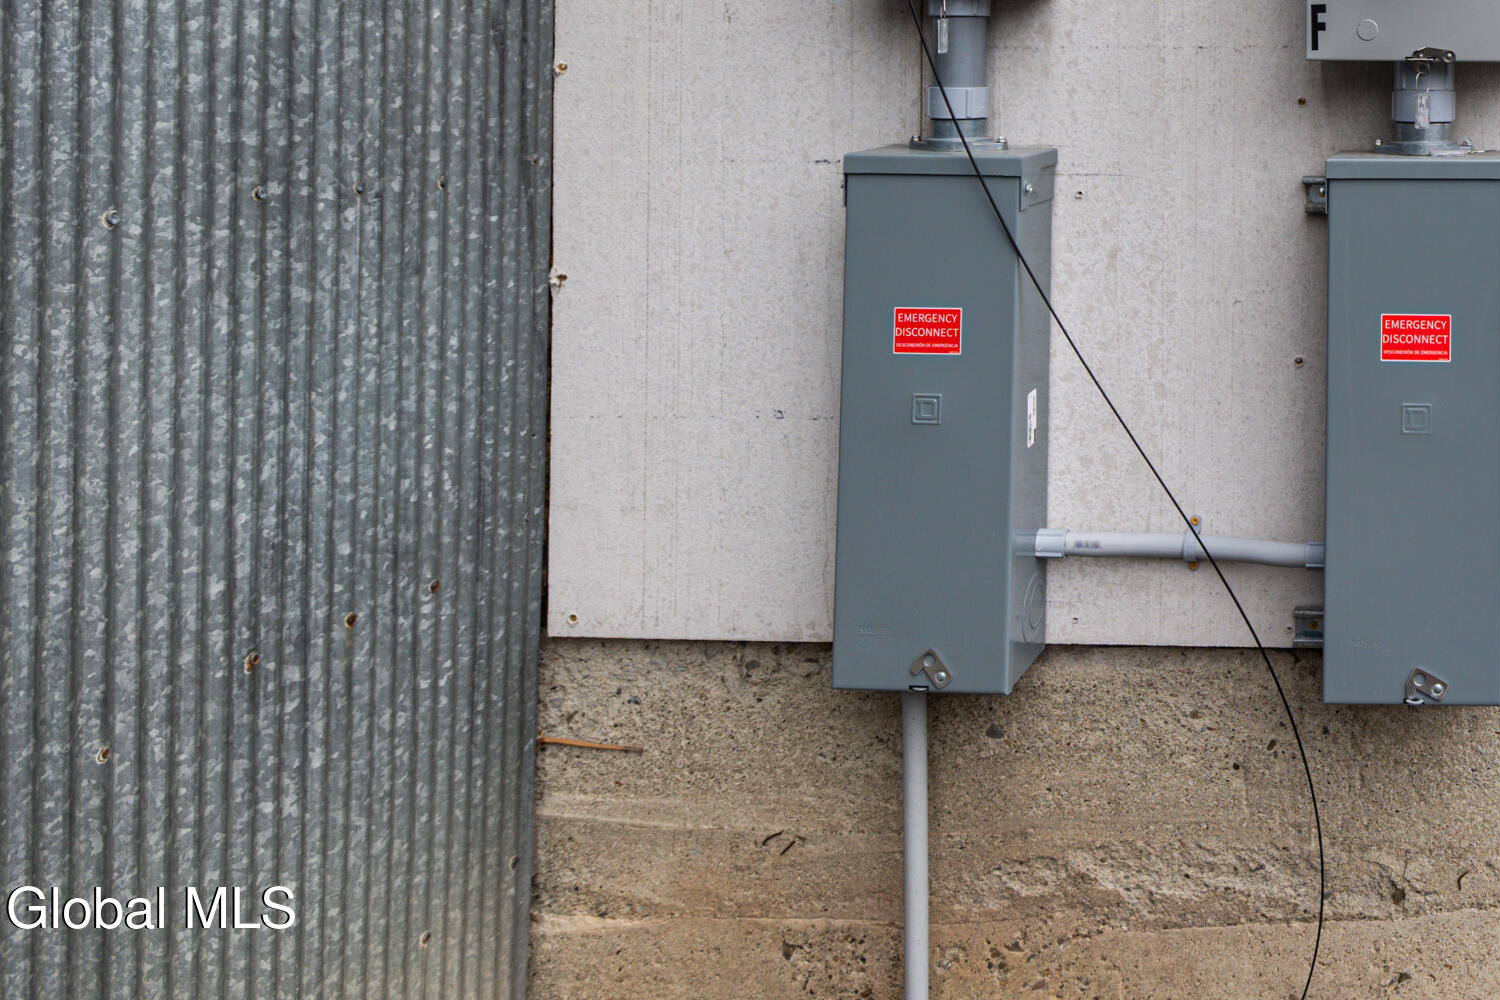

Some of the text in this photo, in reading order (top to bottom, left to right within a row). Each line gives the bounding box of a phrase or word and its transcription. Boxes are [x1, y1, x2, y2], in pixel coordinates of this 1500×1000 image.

[1311, 4, 1326, 51] F
[897, 313, 958, 323] EMERGENCY
[1384, 320, 1447, 330] EMERGENCY
[895, 327, 959, 337] DISCONNECT
[1382, 334, 1448, 344] DISCONNECT
